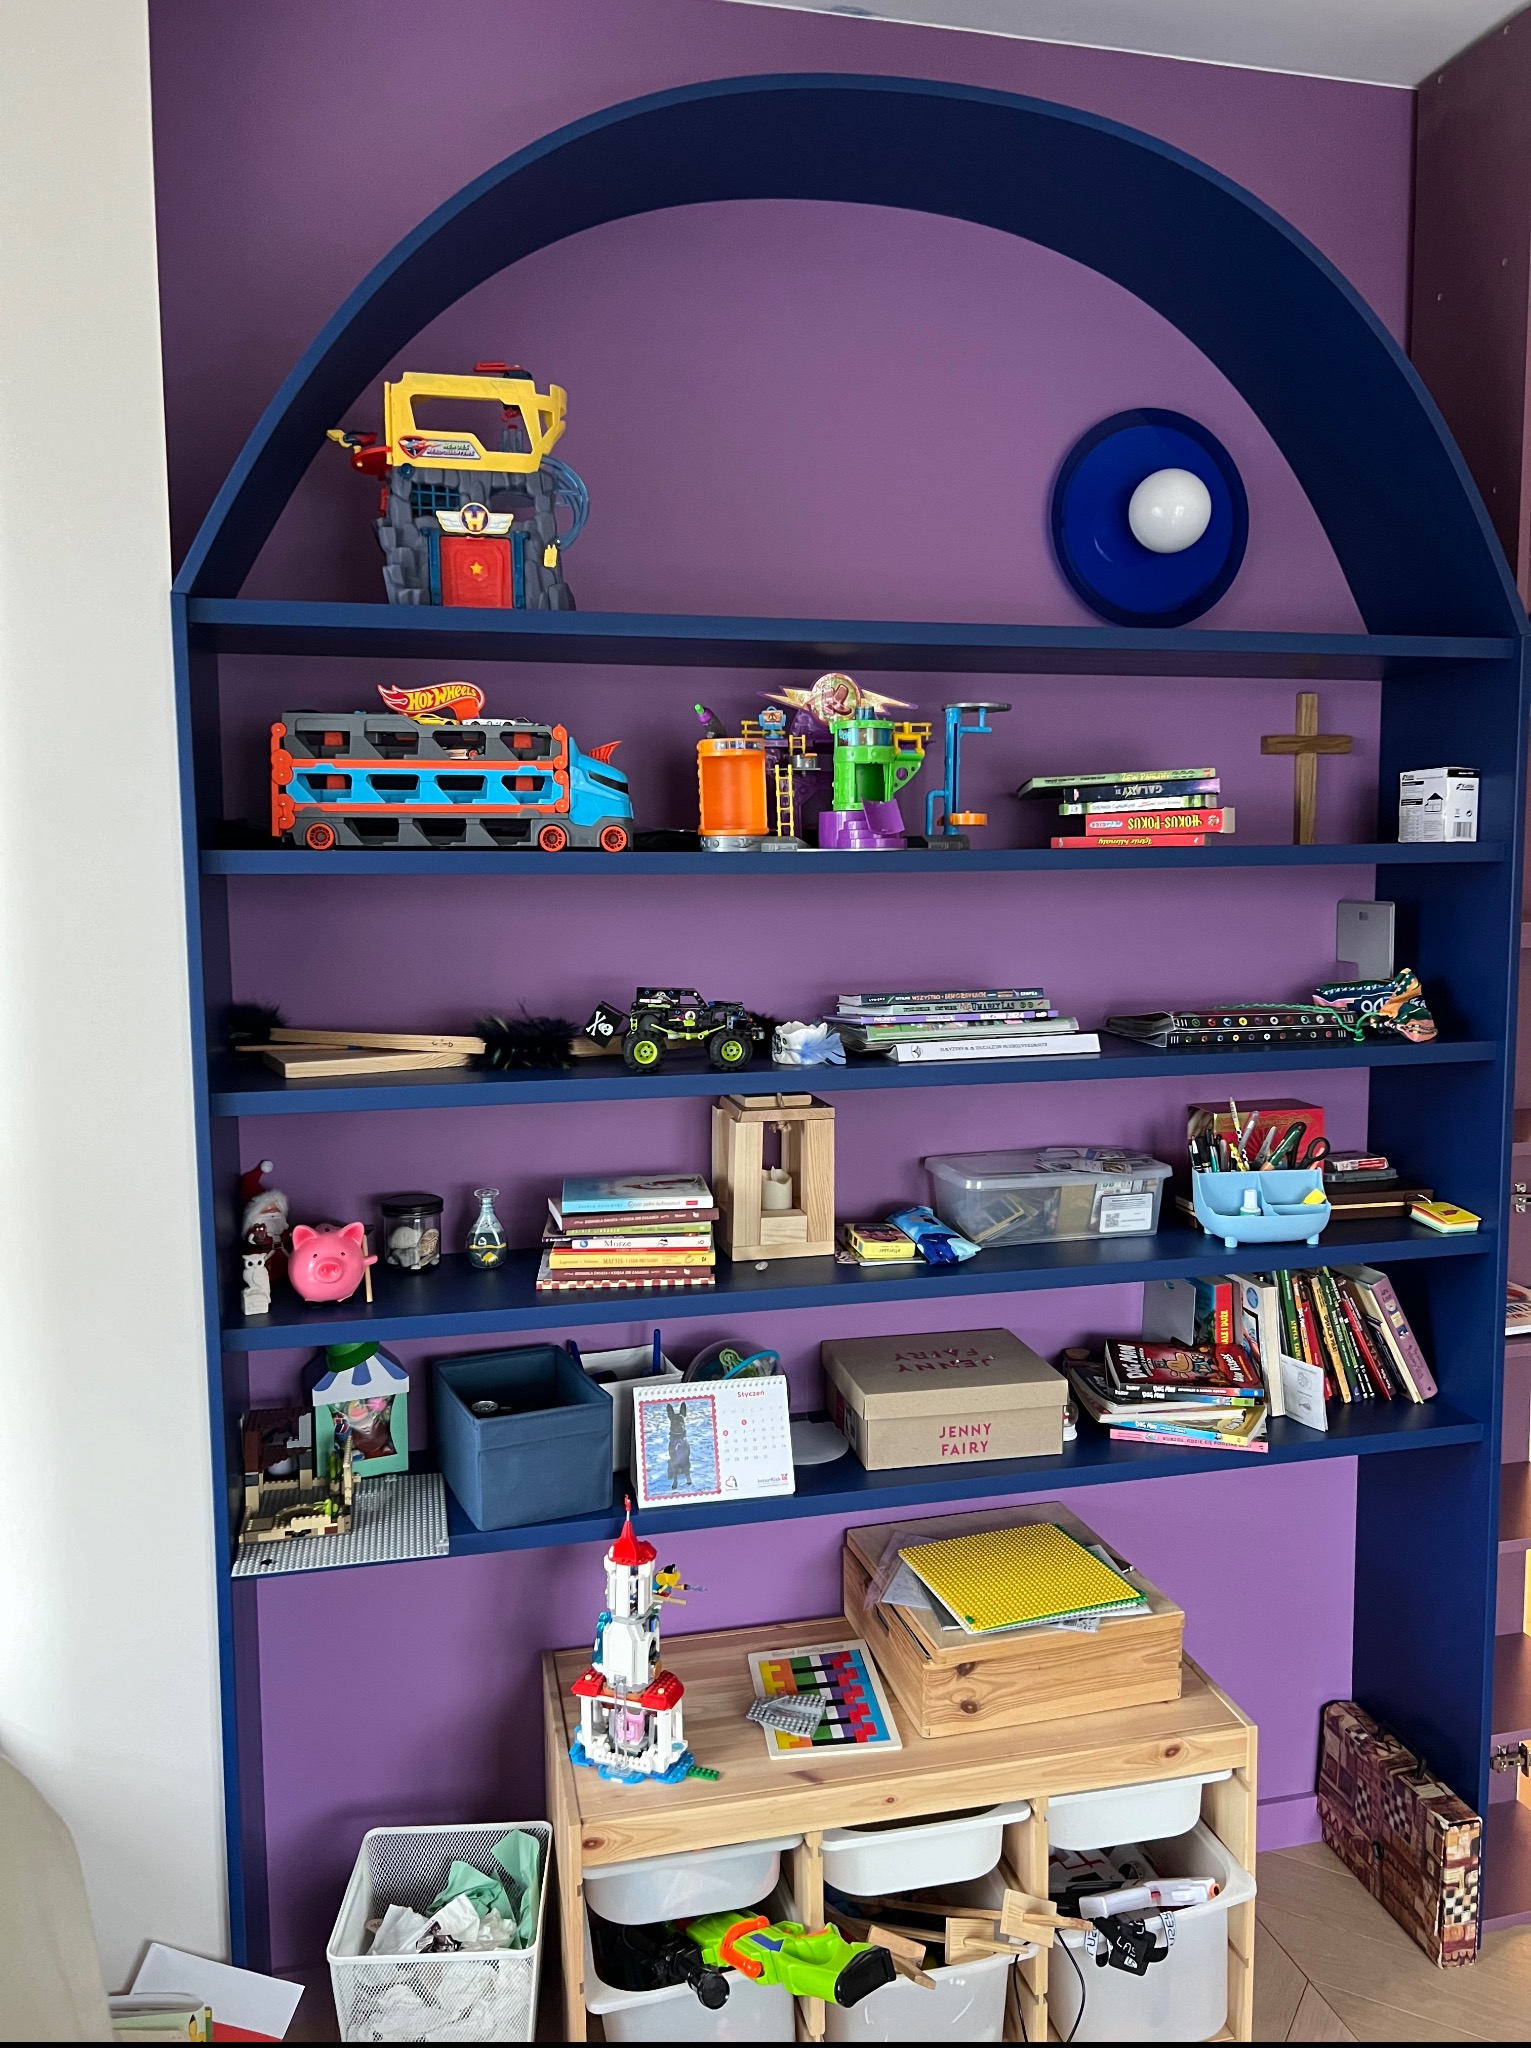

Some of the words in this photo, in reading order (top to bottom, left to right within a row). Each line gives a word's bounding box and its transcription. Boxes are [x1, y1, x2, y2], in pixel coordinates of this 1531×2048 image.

[1121, 784, 1164, 798] GALAXY
[1127, 814, 1203, 831] HOKUS-POKUS
[894, 1348, 979, 1361] FAIRY
[898, 1359, 991, 1373] JENNY
[737, 1390, 765, 1398] Styczeń
[939, 1422, 992, 1438] JENNY
[941, 1440, 989, 1456] FAIRY
[797, 1644, 844, 1655] Intelligence
